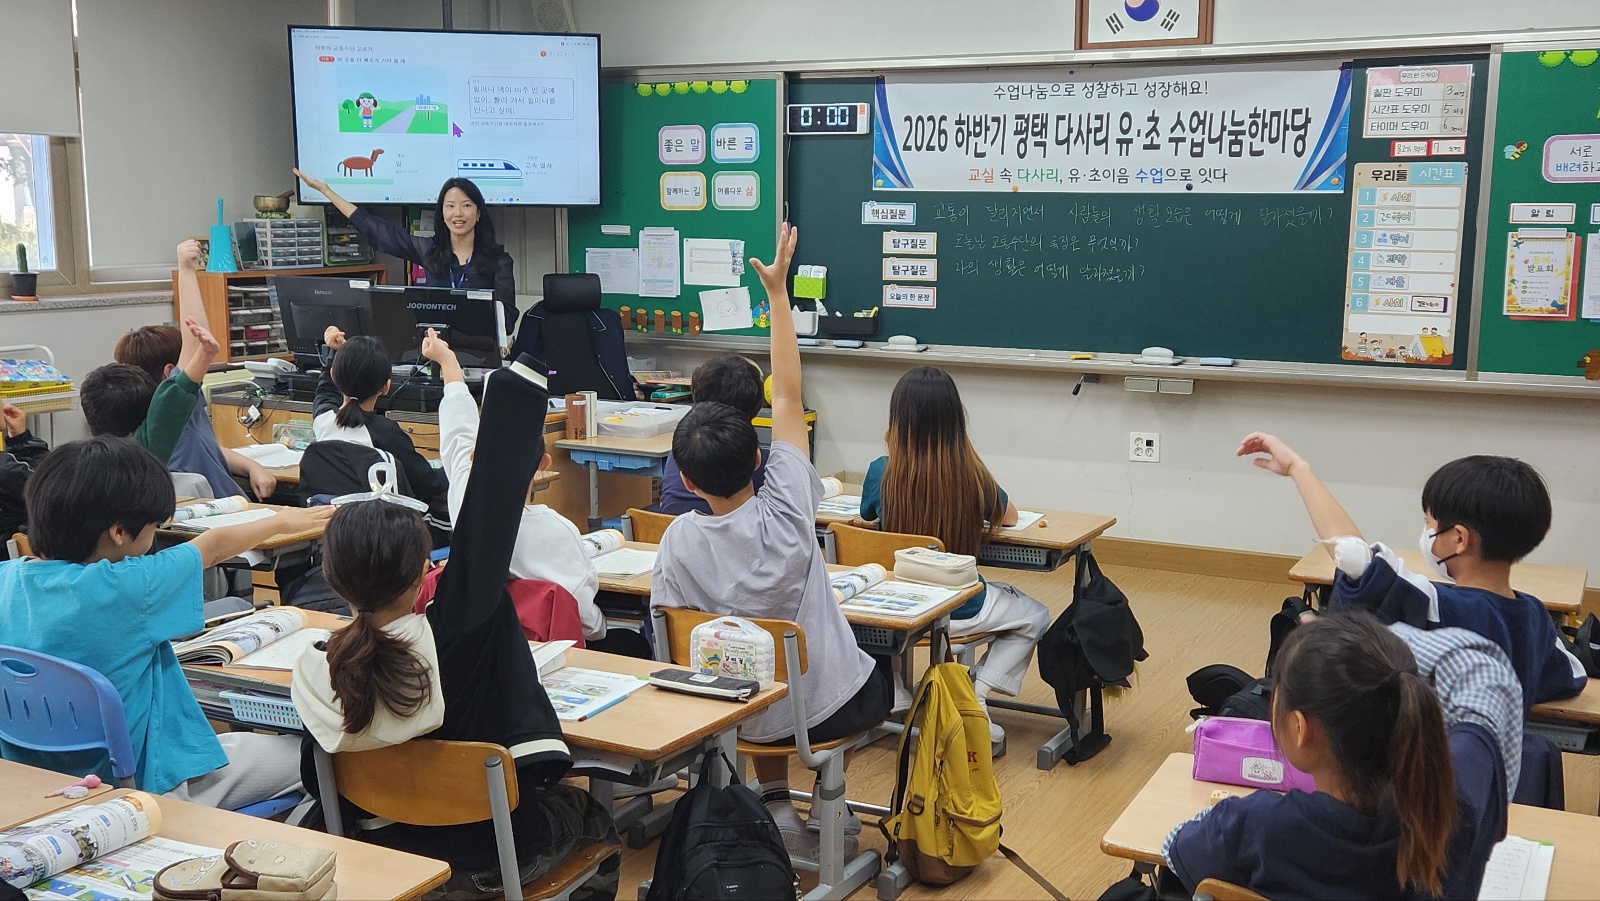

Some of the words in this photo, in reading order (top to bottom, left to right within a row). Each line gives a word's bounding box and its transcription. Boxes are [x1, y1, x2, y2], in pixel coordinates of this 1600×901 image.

[993, 83, 1076, 100] 수업나눔으로
[1082, 80, 1138, 99] 성찰하고
[1144, 80, 1208, 98] 성장해요!
[1374, 88, 1391, 97] 칠판
[1395, 88, 1422, 97] 도우미
[1446, 86, 1454, 96] 3
[1372, 104, 1399, 114] 시간표
[1402, 104, 1430, 114] 도우미
[1444, 103, 1453, 114] 5
[1371, 122, 1398, 131] 타이머
[1401, 121, 1429, 131] 도우미
[1443, 118, 1448, 129] 6
[902, 114, 948, 152] 2026
[954, 112, 1007, 159] 하반기
[1013, 112, 1049, 159] 평택
[1055, 111, 1110, 156] 다사리
[1168, 106, 1312, 158] 수업나눔한마당
[664, 139, 684, 152] 좋은
[690, 138, 700, 152] 말
[716, 137, 737, 150] 바른
[744, 137, 754, 150] 글
[1570, 146, 1593, 157] 서로
[969, 168, 994, 184] 교실
[1000, 168, 1012, 183] 속
[1017, 168, 1063, 184] 다사리,
[1135, 167, 1193, 184] 수업으로
[1198, 168, 1228, 184] 잇다
[1371, 170, 1407, 181] 우리들
[1420, 168, 1454, 180] 시간표
[694, 186, 700, 196] 길
[746, 186, 754, 196] 삶
[1365, 192, 1369, 200] 1
[1390, 192, 1411, 202] 사회
[871, 208, 907, 220] 핵심질문
[934, 202, 969, 225] 교통이
[1069, 202, 1111, 227] 사람들의
[1363, 214, 1369, 222] 2
[1392, 212, 1411, 223] 국어
[892, 238, 928, 249] 탐구질문
[1361, 234, 1367, 243] 3
[1390, 233, 1409, 245] 영어
[1358, 256, 1364, 265] 4
[1386, 254, 1407, 265] 과학
[892, 264, 928, 275] 탐구질문
[1358, 277, 1364, 286] 5
[407, 303, 457, 311] JOOYONTECH
[1356, 298, 1362, 307] 6
[1383, 298, 1403, 307] 사회
